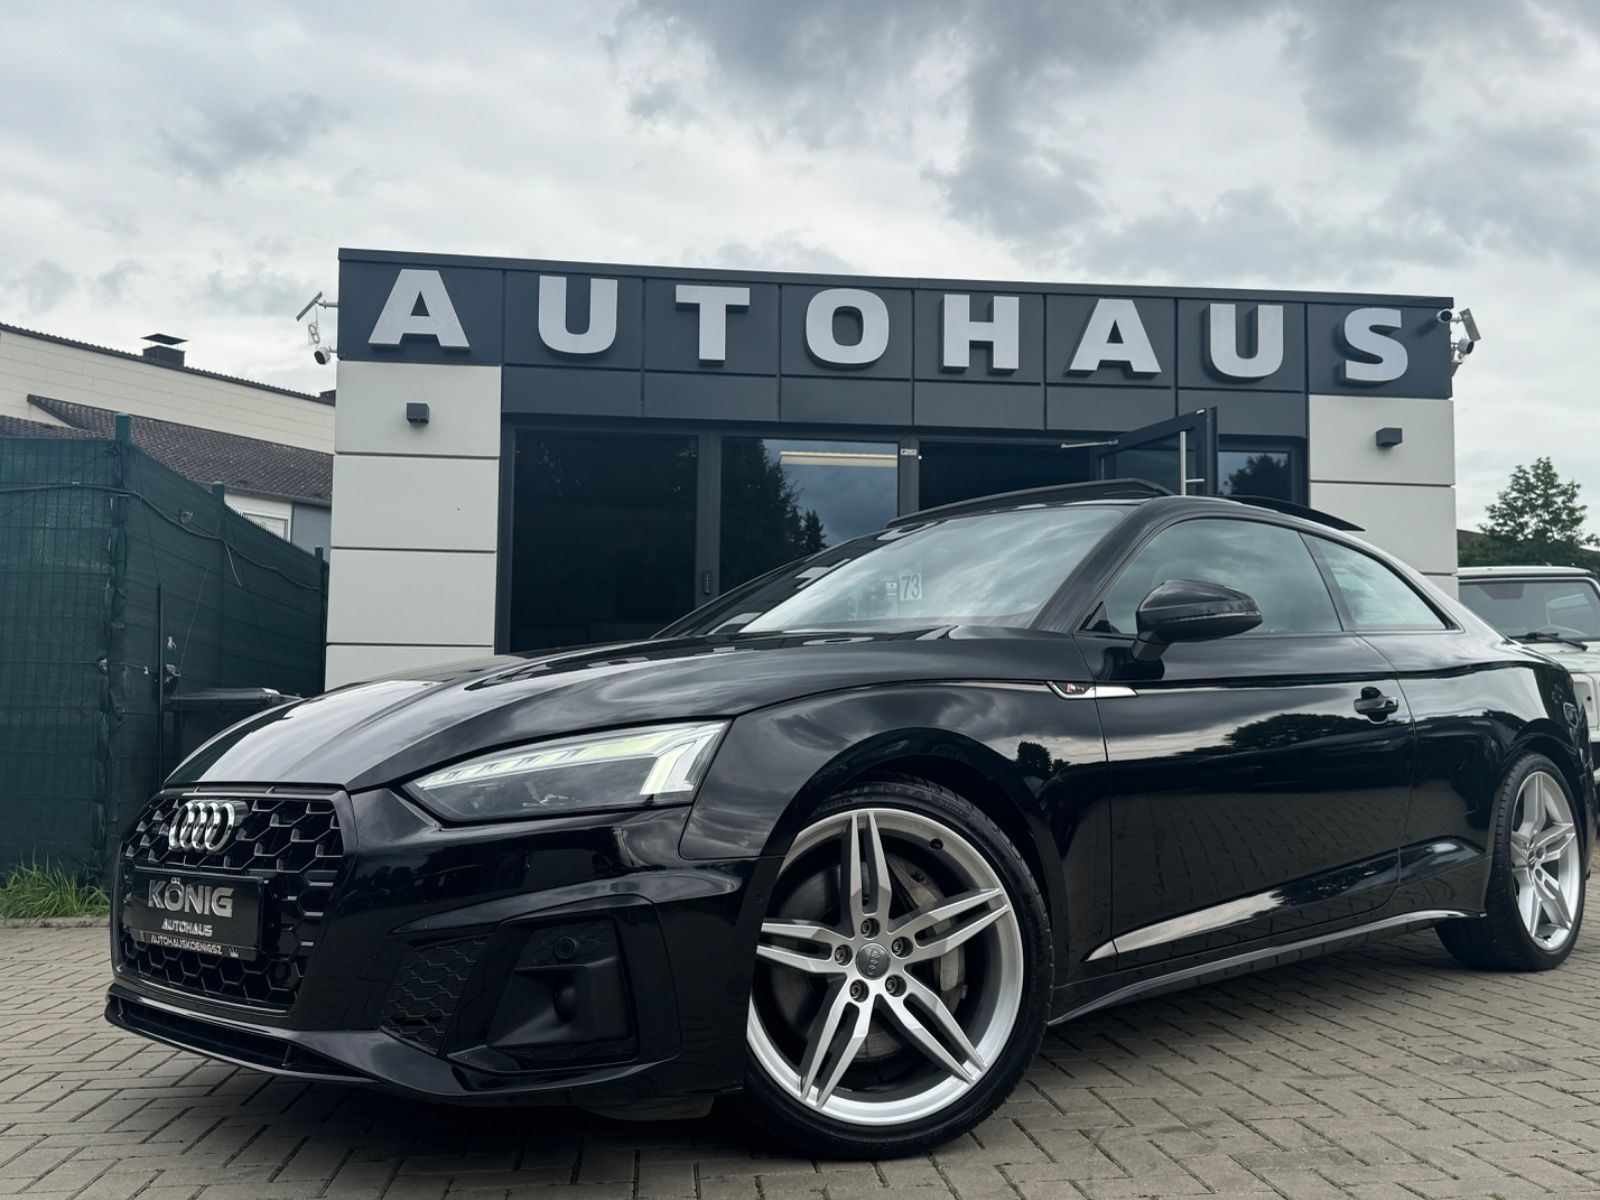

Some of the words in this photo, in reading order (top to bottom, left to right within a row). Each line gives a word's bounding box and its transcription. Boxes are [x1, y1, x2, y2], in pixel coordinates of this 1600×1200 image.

[367, 267, 1410, 384] AUTOHAUS
[901, 574, 921, 600] 73
[149, 878, 234, 918] KÖNIG
[161, 919, 213, 937] AUTOHAUS
